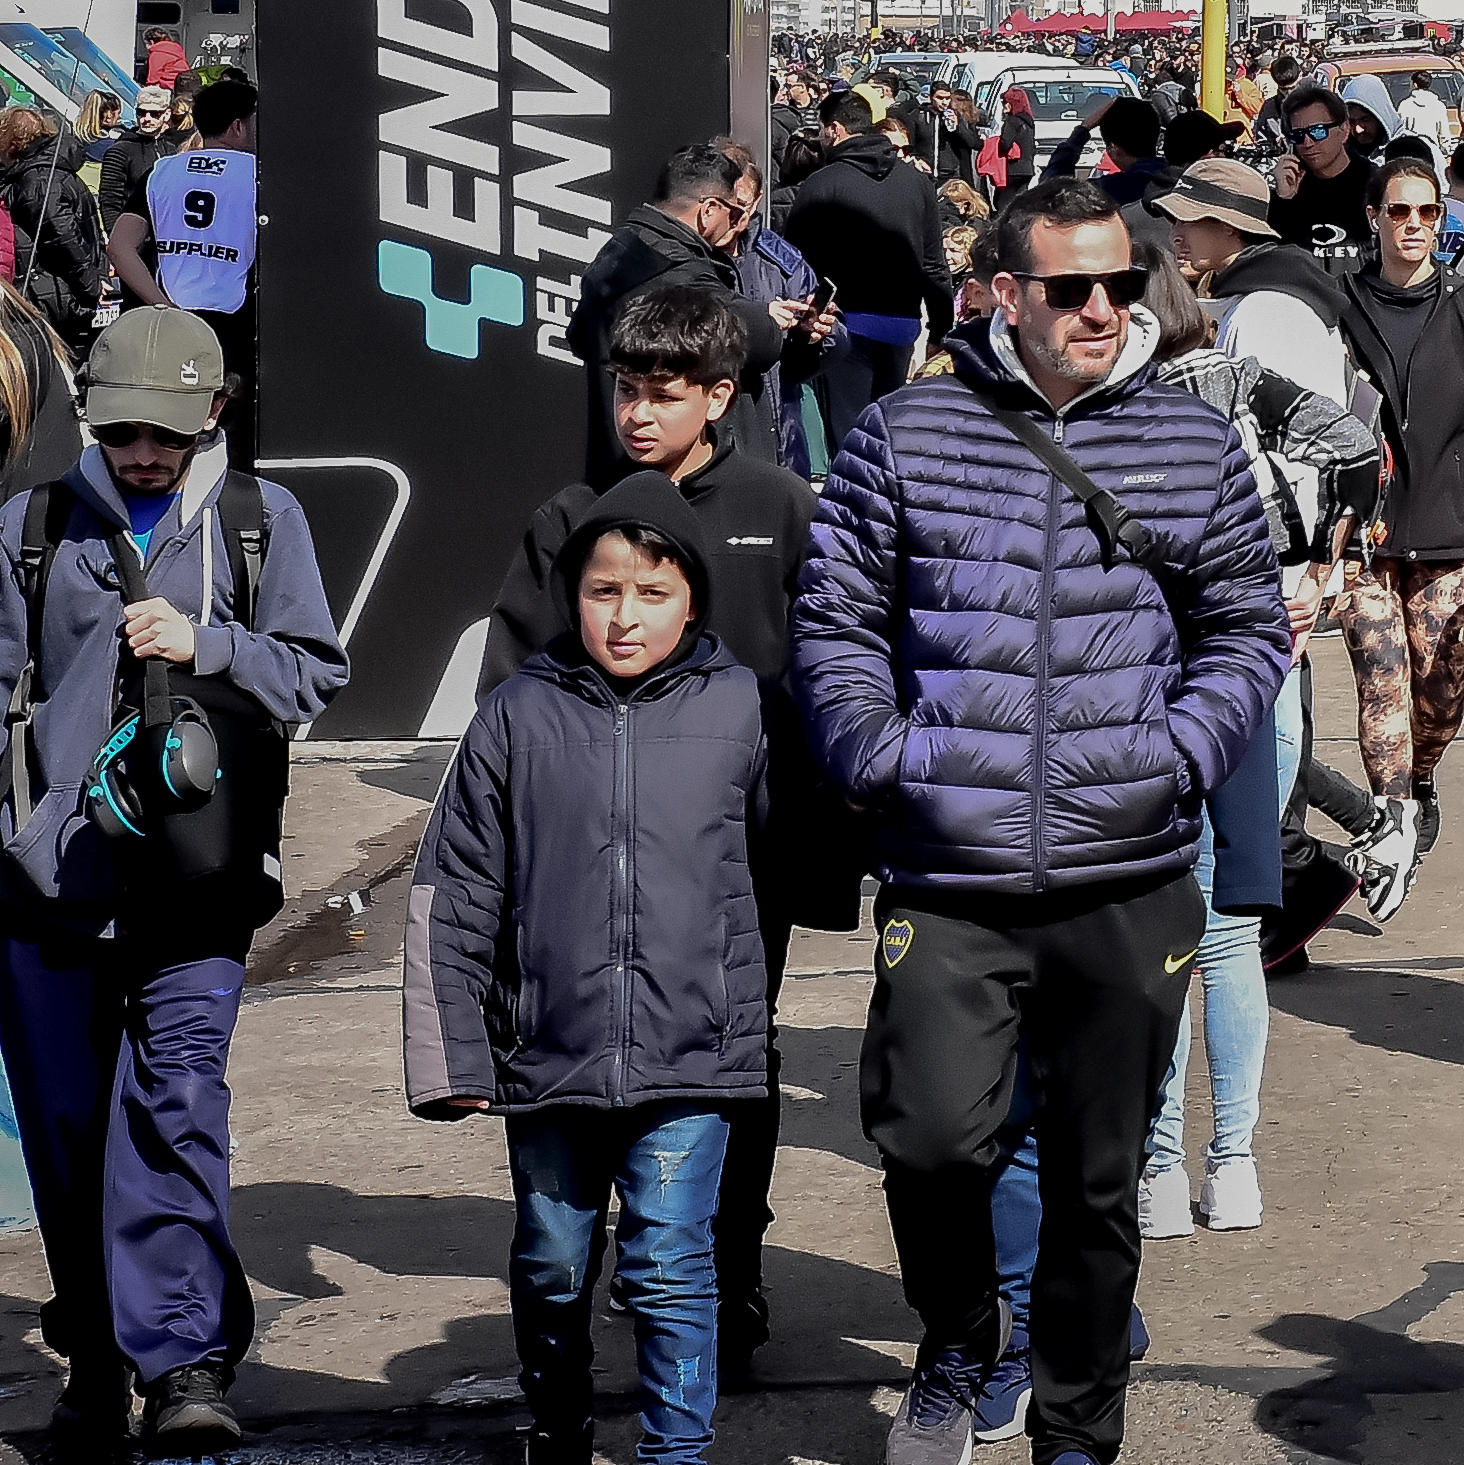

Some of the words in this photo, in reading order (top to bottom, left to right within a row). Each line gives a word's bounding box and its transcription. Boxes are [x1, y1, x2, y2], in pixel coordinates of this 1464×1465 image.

[183, 189, 217, 230] 9
[156, 239, 240, 264] SUPPLIER
[1313, 246, 1359, 258] KLEY
[536, 274, 584, 367] DEL
